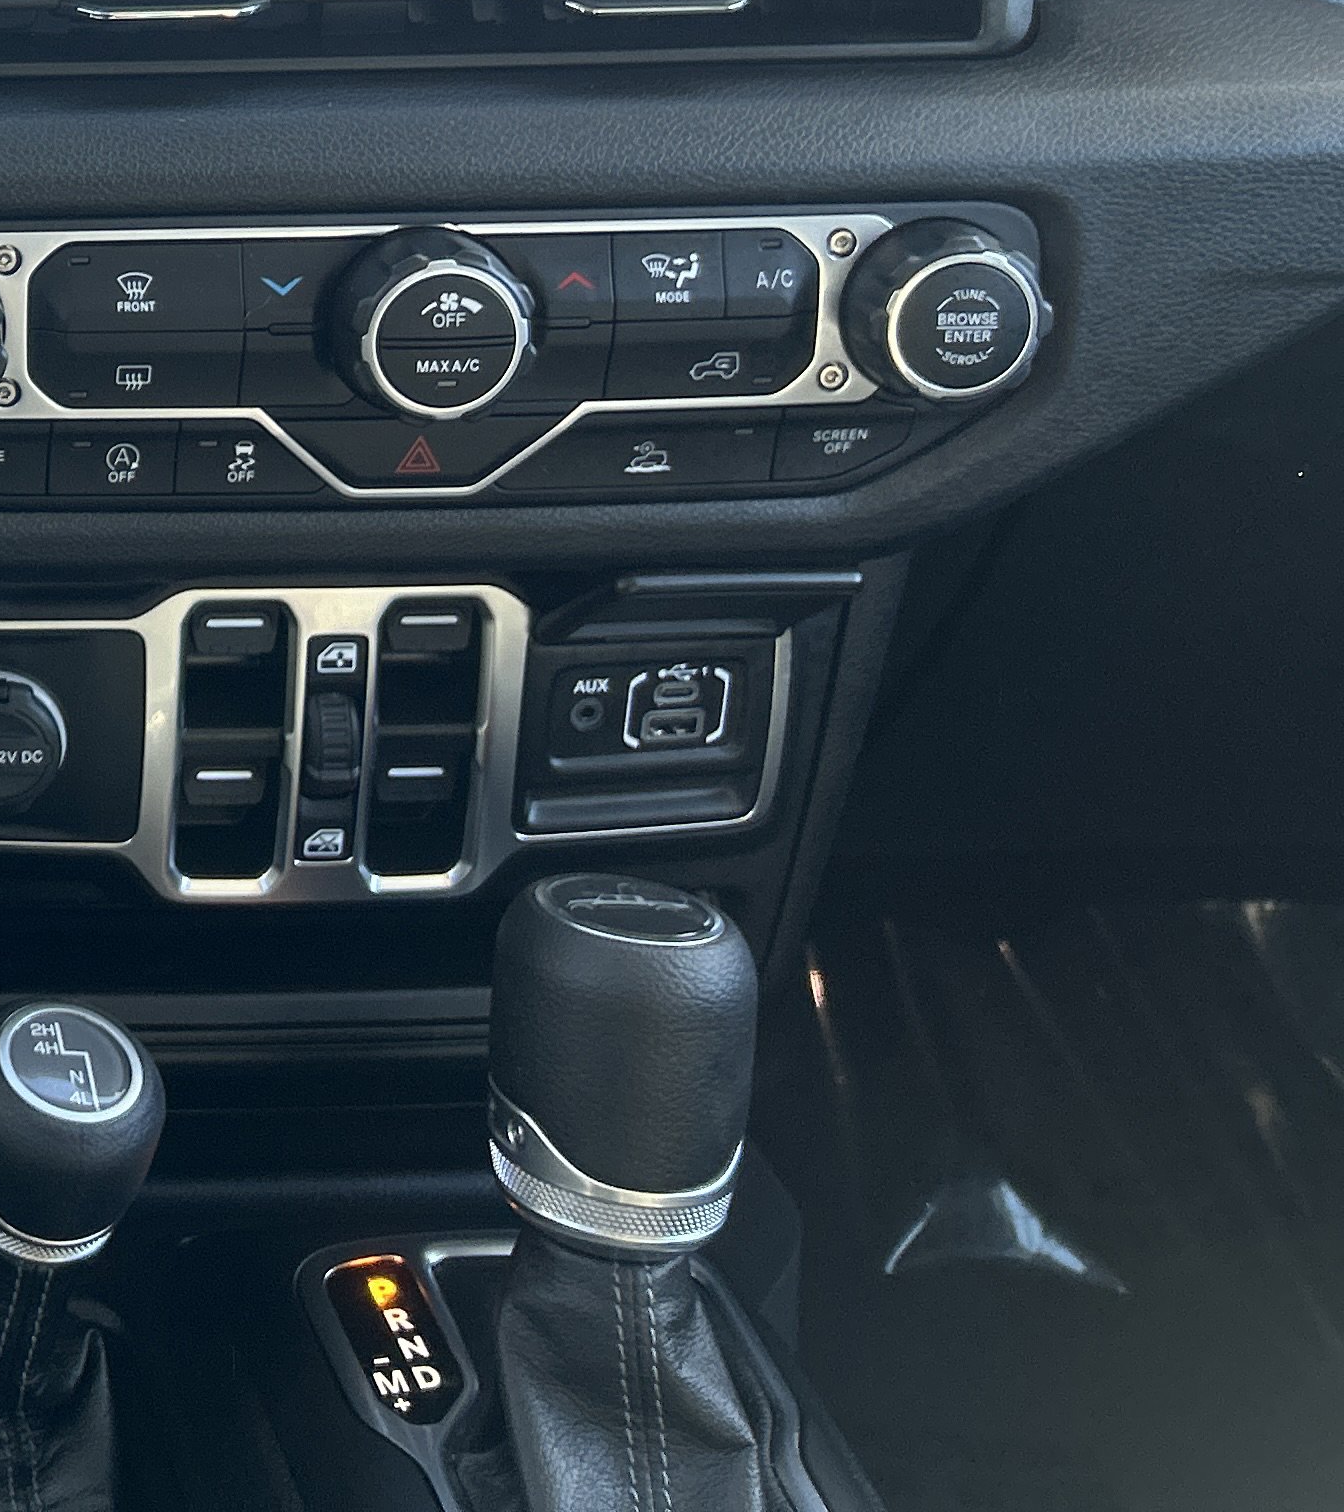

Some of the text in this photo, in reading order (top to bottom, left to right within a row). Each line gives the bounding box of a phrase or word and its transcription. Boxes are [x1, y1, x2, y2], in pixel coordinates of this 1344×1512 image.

[755, 268, 795, 289] A/C
[655, 290, 691, 304] MODE
[953, 288, 988, 302] TUNE
[116, 301, 156, 313] FRONT
[432, 312, 466, 329] OFF
[937, 311, 999, 326] BROWSE
[944, 329, 991, 343] ENTER
[941, 350, 989, 366] SCROLL
[416, 358, 480, 374] MAX A/C
[812, 427, 869, 443] SCREEN
[823, 440, 853, 455] OFF
[108, 470, 137, 483] OFF
[226, 470, 256, 483] OFF
[573, 677, 610, 694] AUX
[21, 748, 44, 764] DC
[29, 1022, 55, 1037] 2H
[33, 1040, 59, 1055] 4H
[69, 1069, 85, 1084] N
[69, 1090, 94, 1105] 4L
[366, 1276, 398, 1310] P
[383, 1307, 415, 1332] R
[397, 1334, 430, 1360] N
[373, 1369, 411, 1396] M
[411, 1365, 442, 1390] D
